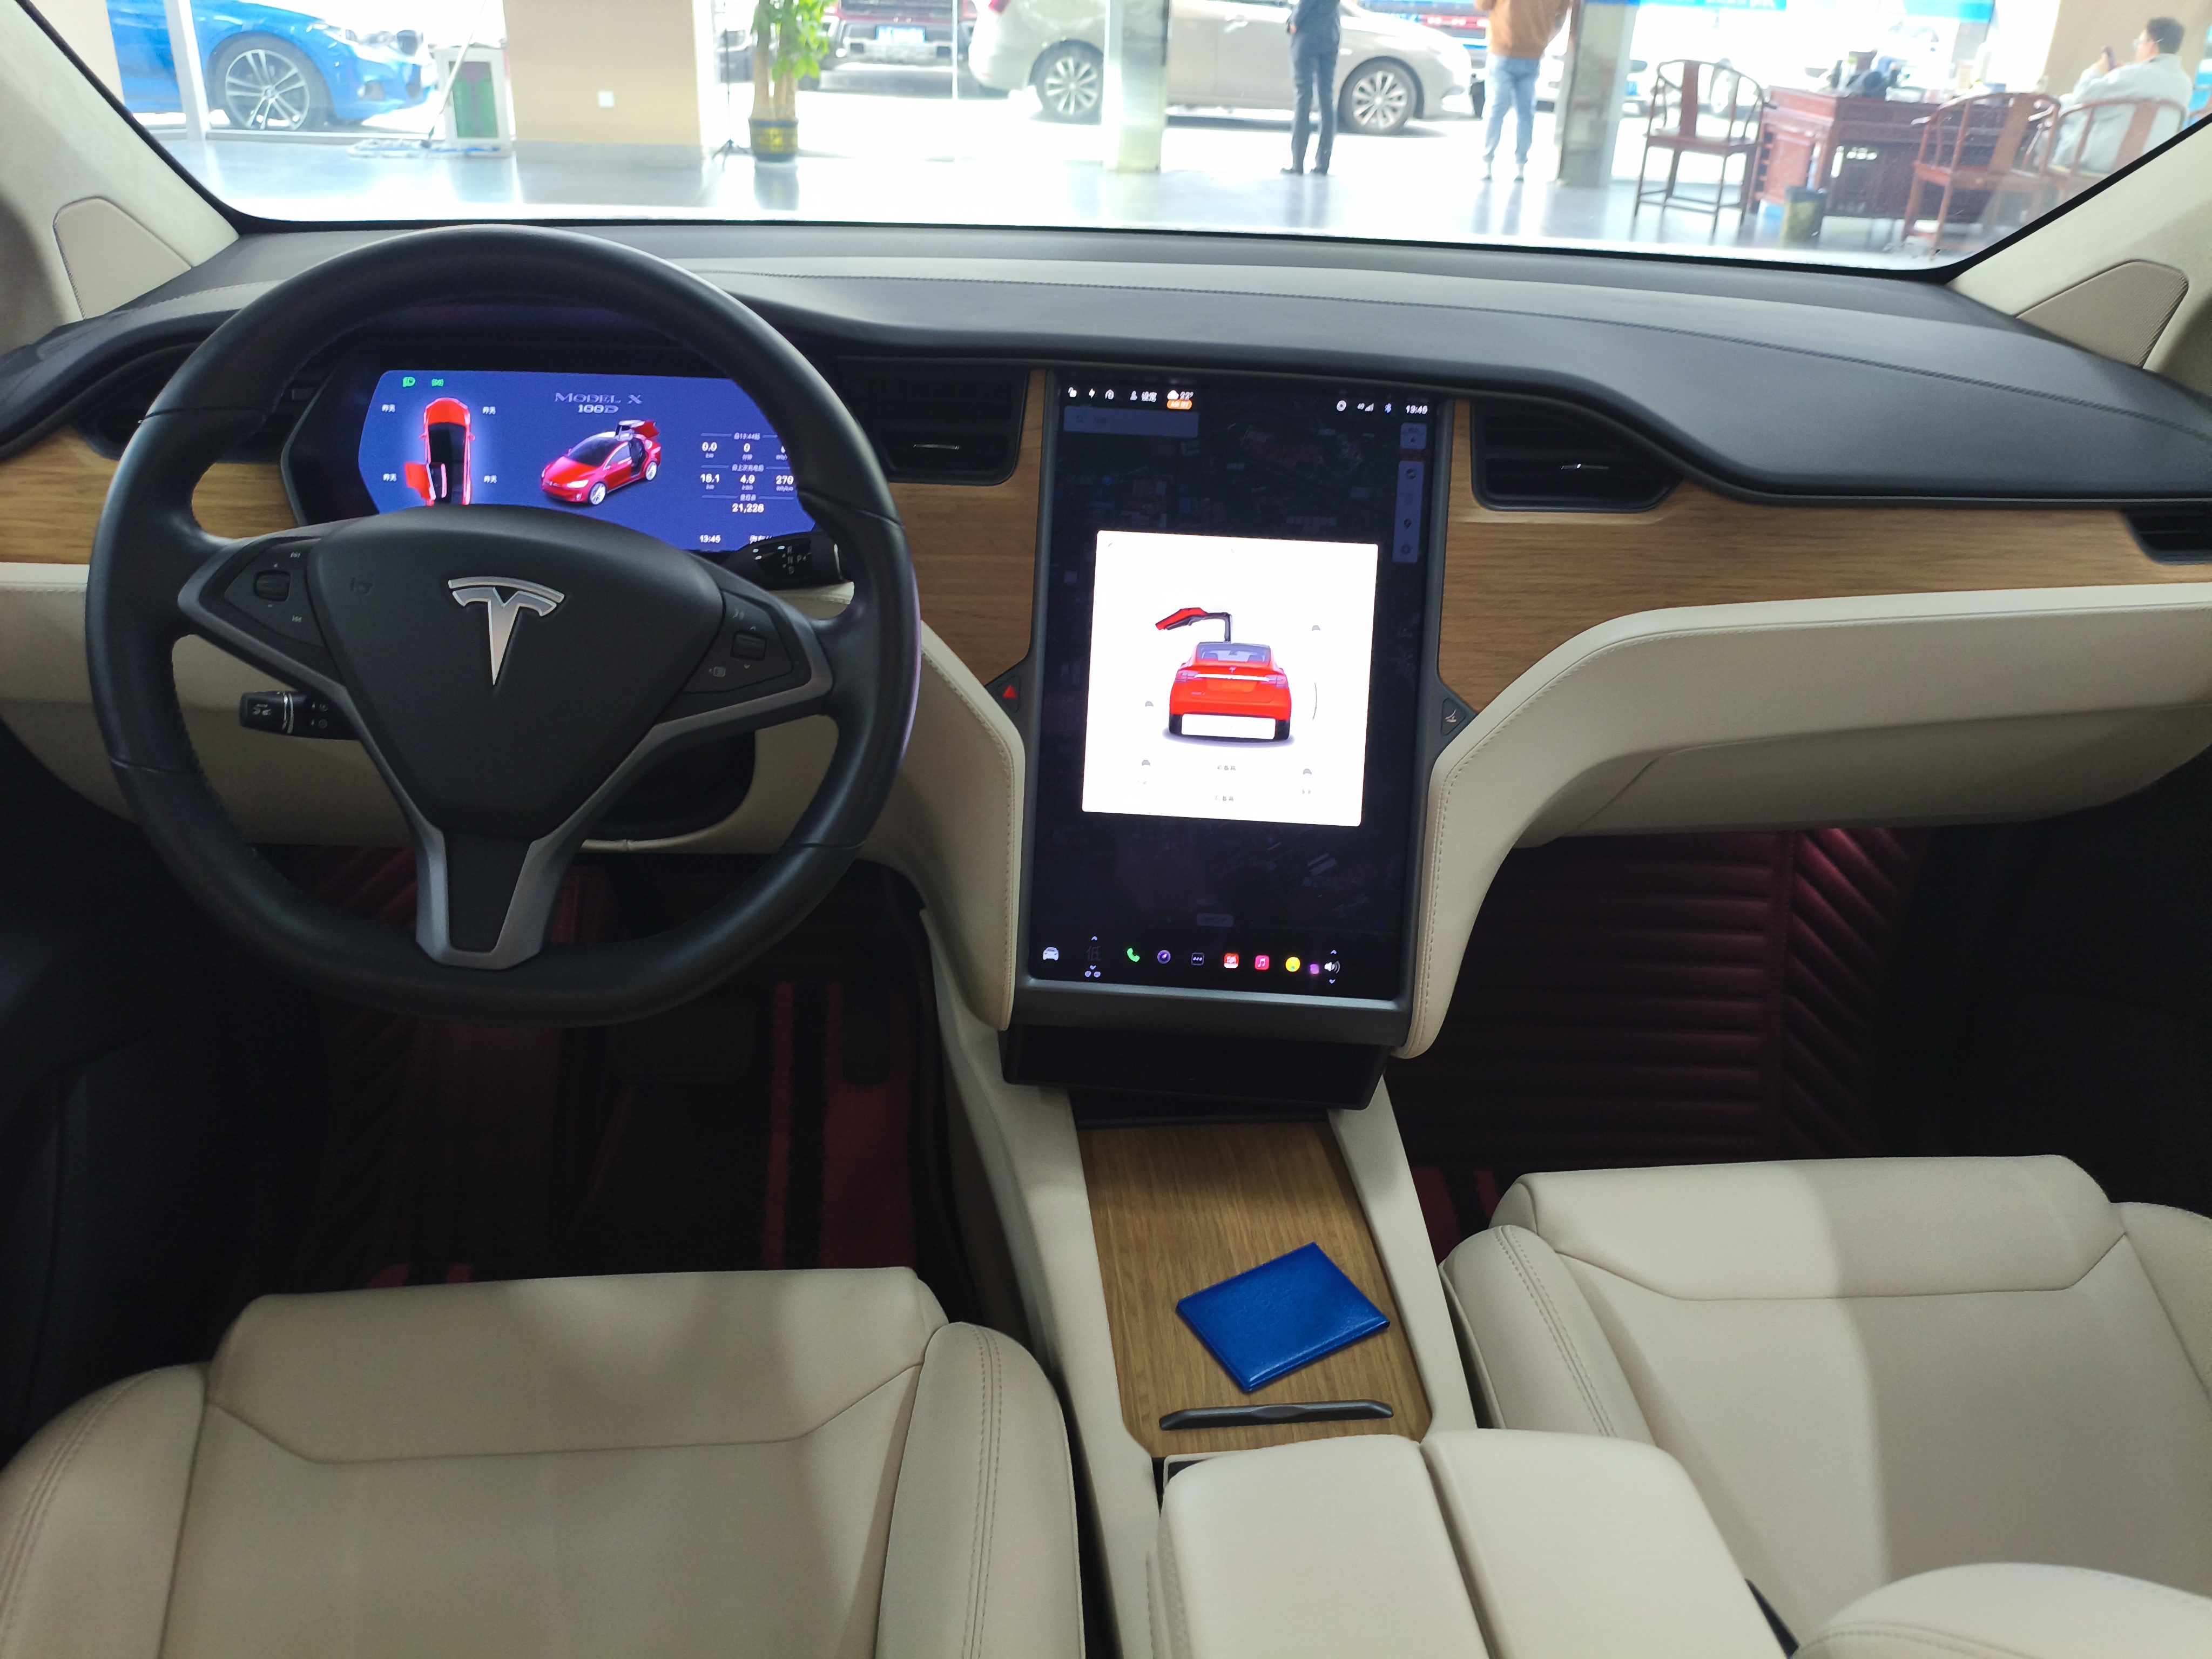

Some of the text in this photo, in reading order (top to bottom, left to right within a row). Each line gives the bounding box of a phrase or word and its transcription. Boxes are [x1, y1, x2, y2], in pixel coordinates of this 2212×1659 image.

[555, 392, 643, 404] MODEL X
[578, 404, 619, 414] 100D
[775, 475, 794, 485] 270
